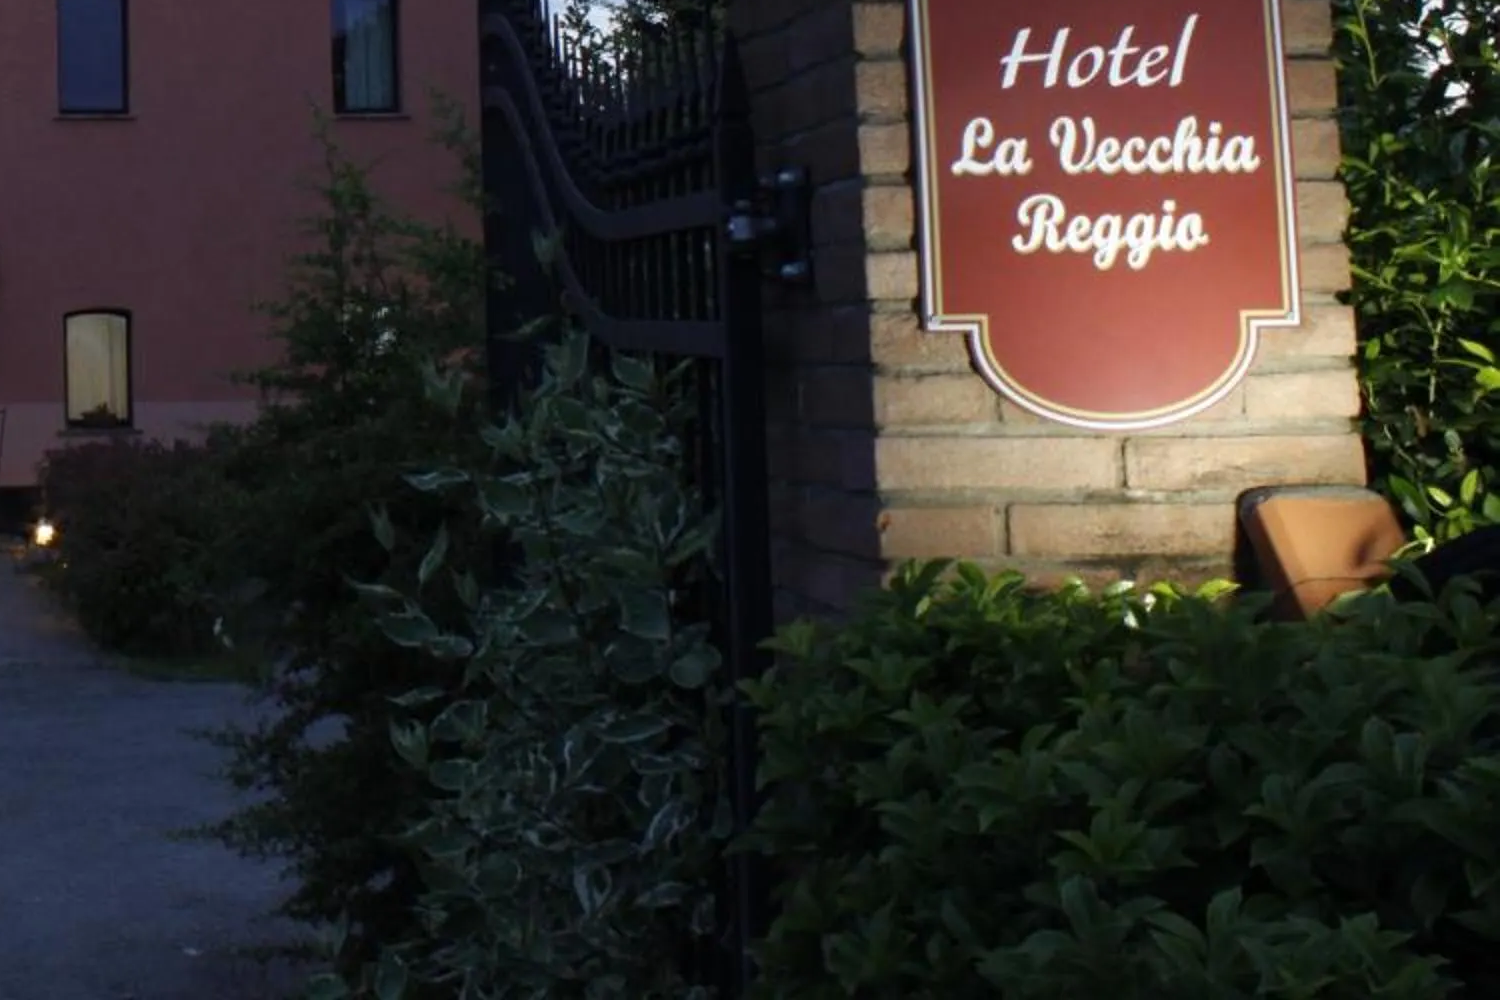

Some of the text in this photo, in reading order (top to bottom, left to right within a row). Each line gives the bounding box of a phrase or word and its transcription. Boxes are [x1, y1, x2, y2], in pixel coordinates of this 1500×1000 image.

[1000, 13, 1199, 89] Hotel
[951, 115, 1260, 175] La Vecchia
[1012, 193, 1209, 270] Reggio
